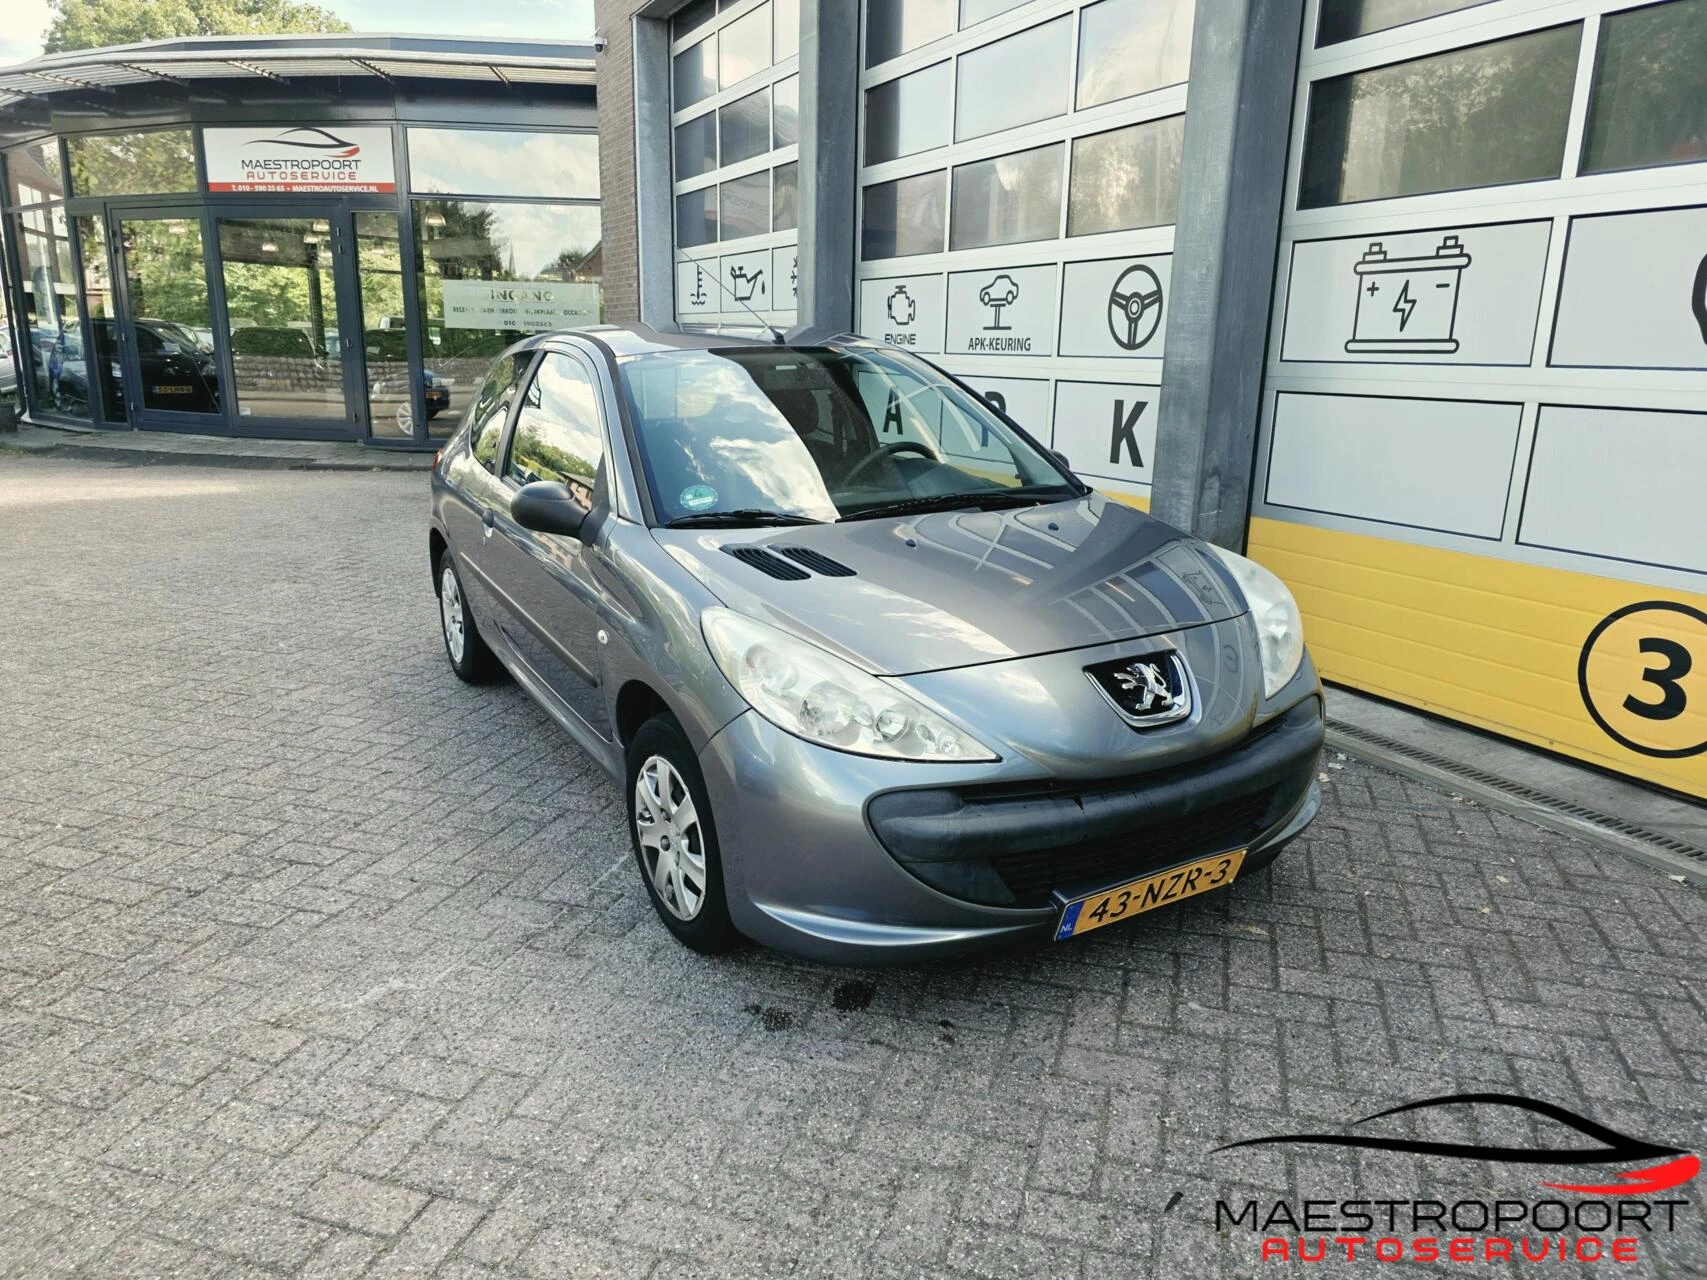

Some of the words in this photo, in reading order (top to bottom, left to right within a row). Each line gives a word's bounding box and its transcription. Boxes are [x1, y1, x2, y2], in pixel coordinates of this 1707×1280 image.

[241, 159, 361, 170] MAESTROPOORT
[246, 171, 357, 180] AUTOSERVICE
[292, 185, 379, 193] MAESTROAUTOSERVICE.NL
[884, 333, 917, 346] ENGINE
[968, 337, 1031, 352] APK-KEURING
[1622, 637, 1692, 721] 3
[1088, 858, 1232, 922] 43-NZR-3
[1060, 924, 1073, 932] NL
